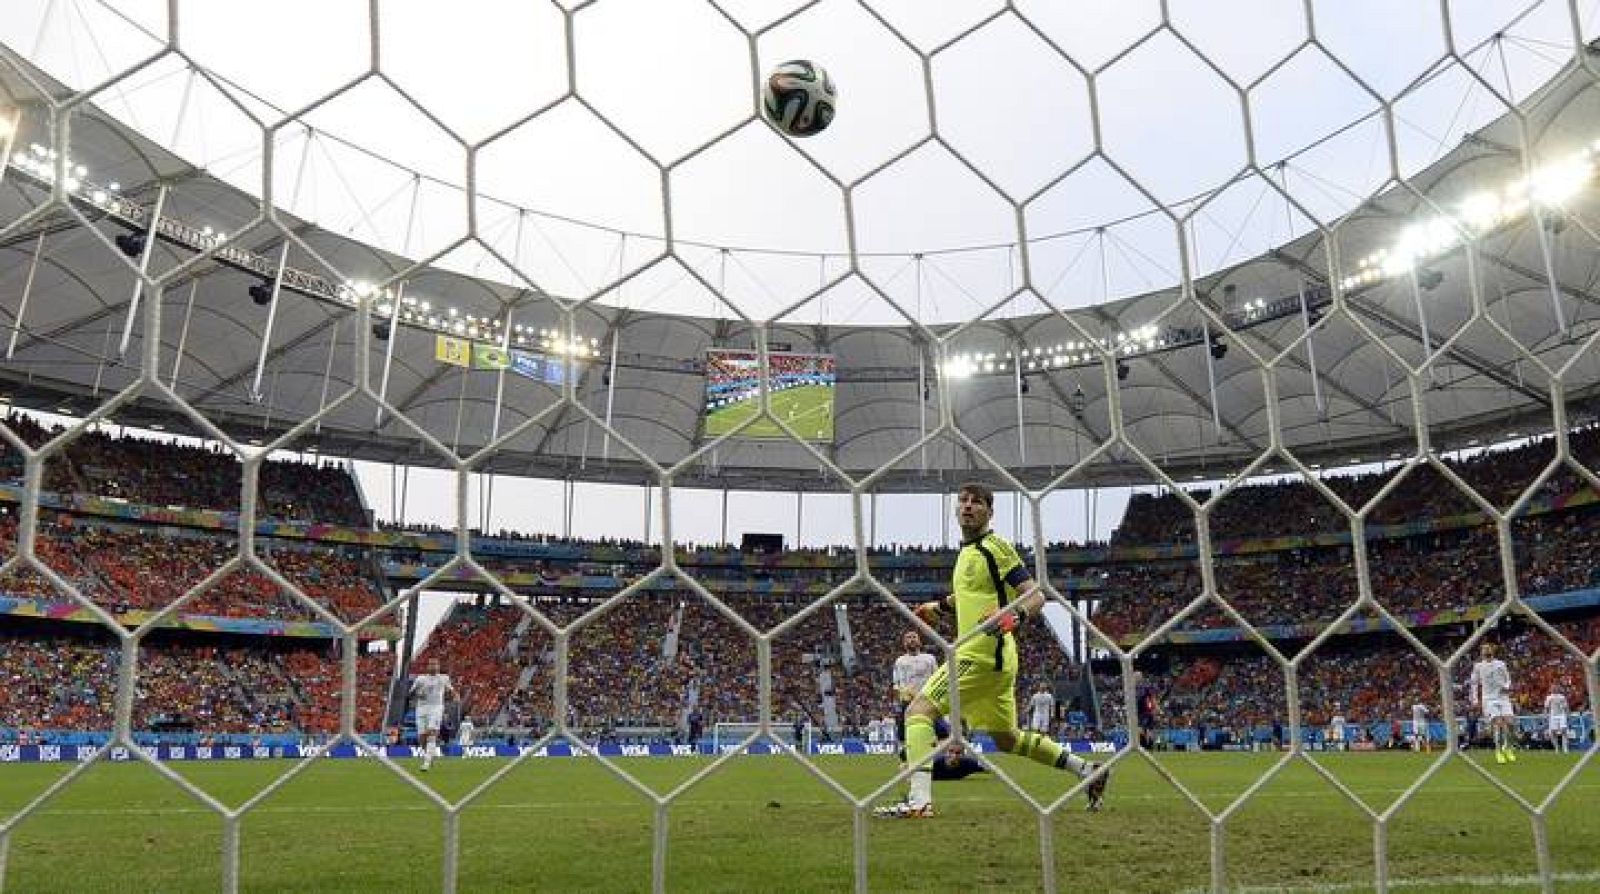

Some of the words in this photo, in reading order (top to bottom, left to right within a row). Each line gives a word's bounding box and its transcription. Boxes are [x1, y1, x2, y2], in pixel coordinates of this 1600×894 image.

[410, 746, 440, 757] VI
[462, 746, 496, 757] VISA
[518, 746, 547, 757] VSA
[619, 745, 649, 756] VISA
[816, 745, 845, 755] VISA
[1088, 743, 1115, 753] VISA
